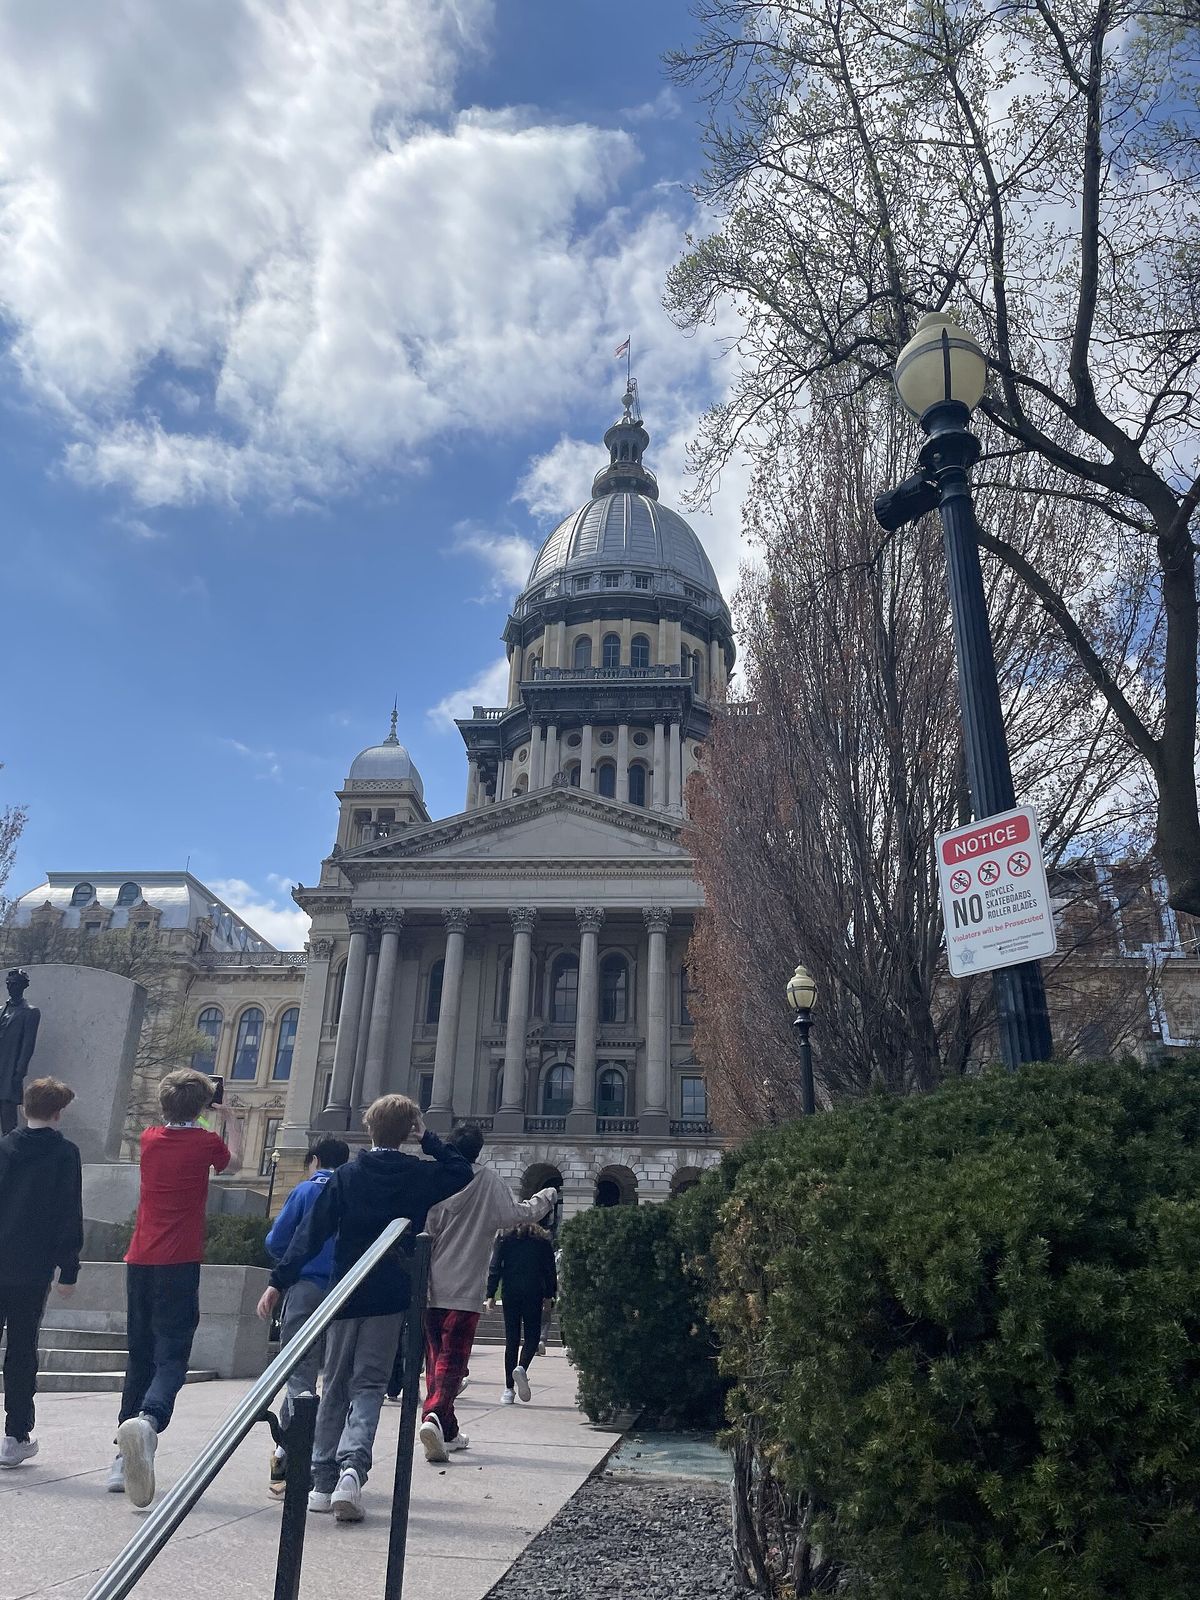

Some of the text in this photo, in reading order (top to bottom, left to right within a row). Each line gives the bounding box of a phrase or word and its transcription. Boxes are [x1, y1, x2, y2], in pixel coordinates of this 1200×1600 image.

[955, 825, 1017, 857] NOTICE
[984, 883, 1015, 899] BICYCLES
[986, 890, 1032, 910] SKATEBOARDS
[953, 894, 983, 928] NO
[987, 898, 1038, 920] ROLLER BLADES
[952, 931, 981, 943] Violators
[982, 926, 995, 935] will
[995, 924, 1004, 932] be
[1004, 913, 1044, 928] Prosecuted
